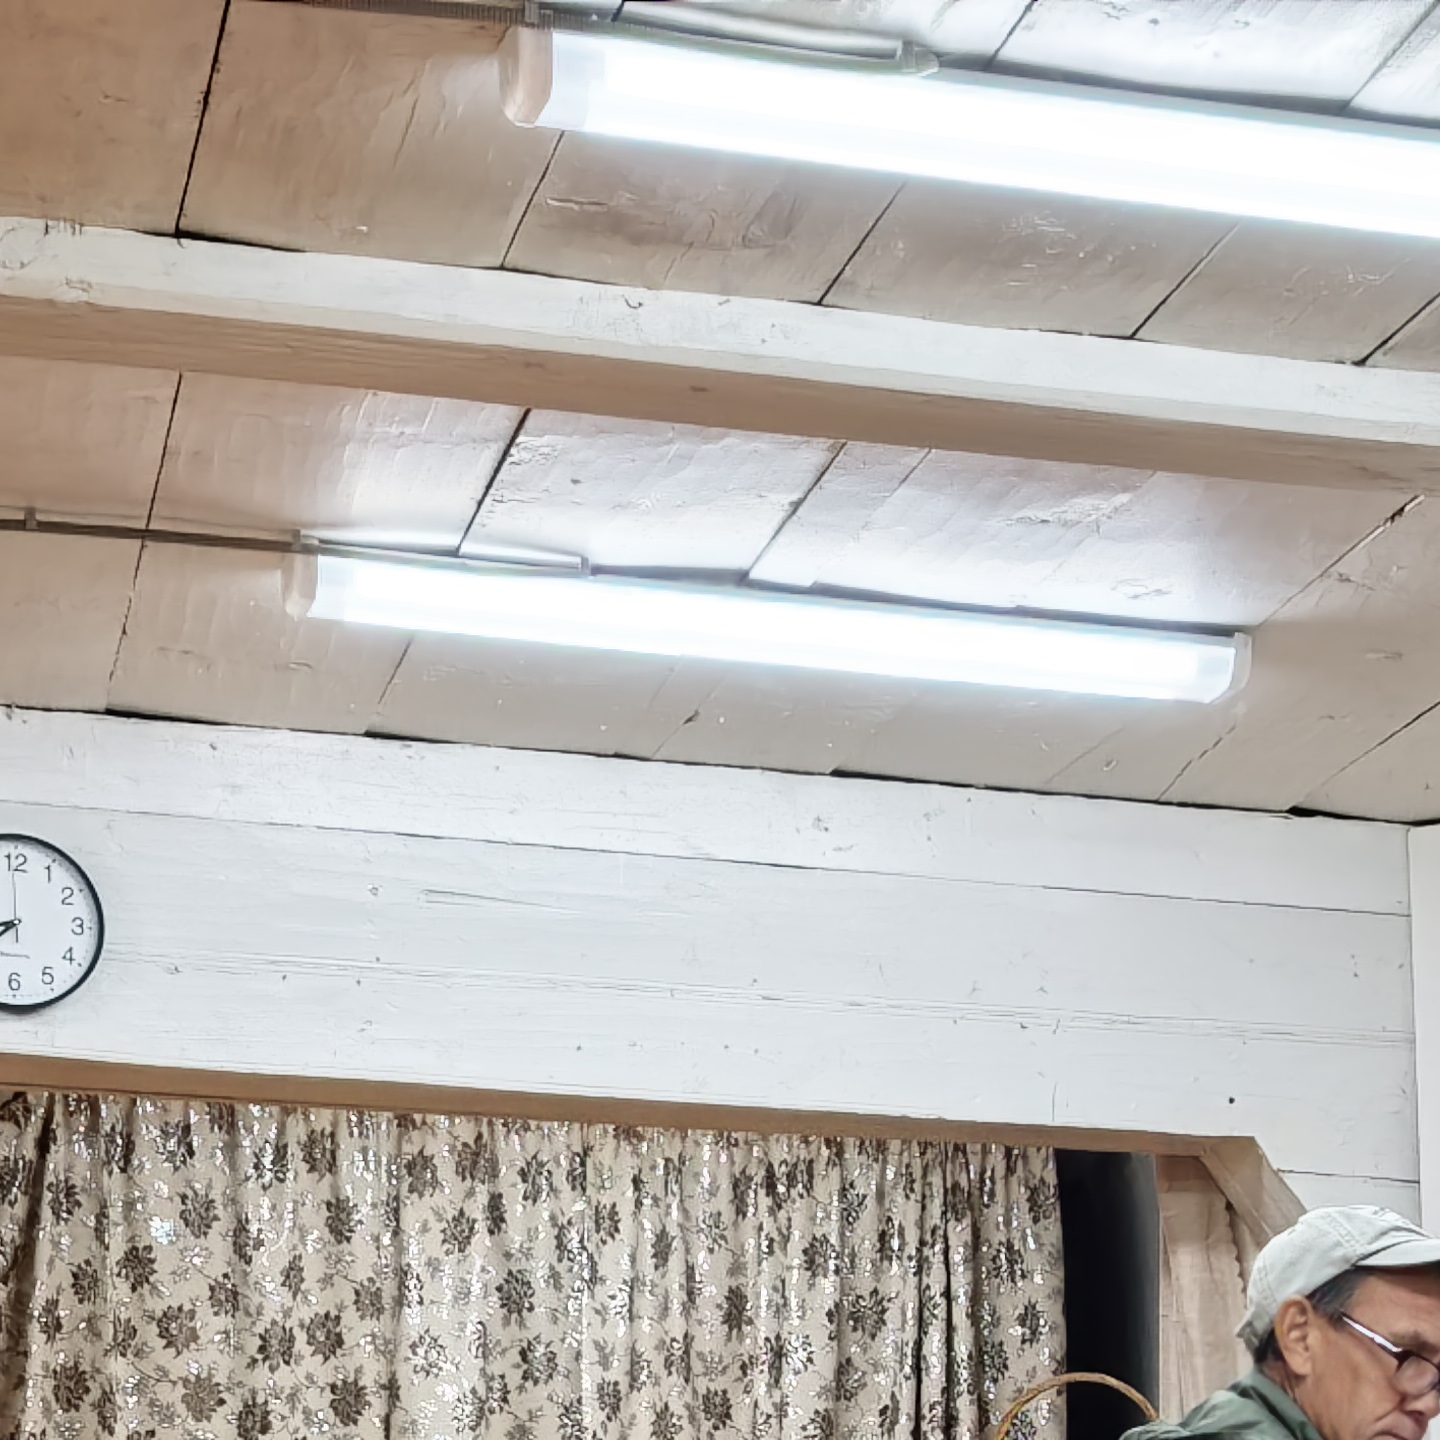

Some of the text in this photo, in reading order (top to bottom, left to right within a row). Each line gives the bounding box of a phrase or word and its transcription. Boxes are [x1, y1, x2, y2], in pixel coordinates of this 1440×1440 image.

[4, 853, 28, 873] 12
[45, 865, 51, 883] 1
[61, 887, 74, 905] 2
[71, 917, 84, 935] 3
[62, 947, 76, 965] 4
[8, 973, 21, 990] 6
[41, 966, 54, 984] 5
